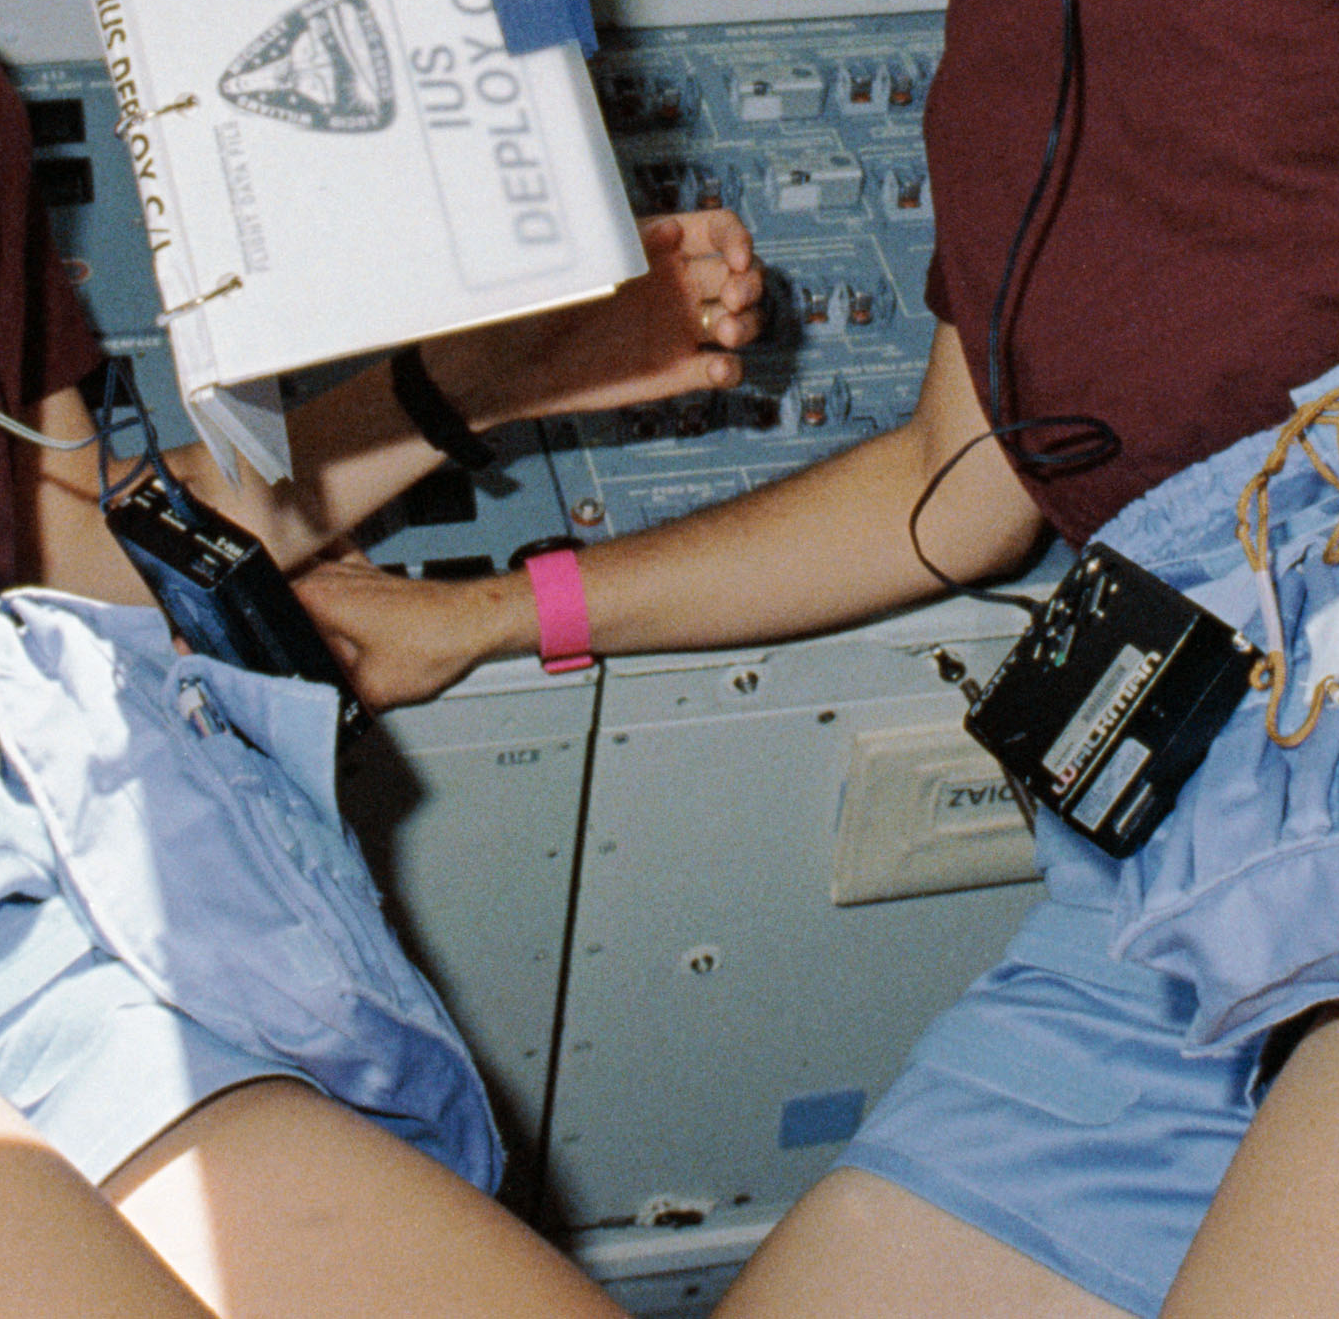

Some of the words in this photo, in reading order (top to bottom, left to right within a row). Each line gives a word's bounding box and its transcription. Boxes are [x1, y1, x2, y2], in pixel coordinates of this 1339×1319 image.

[111, 55, 158, 181] DEPOY
[410, 45, 472, 129] IUS
[463, 37, 563, 247] DEPLOY
[1051, 651, 1163, 795] WALKMAN
[946, 784, 1016, 808] DIAZ
